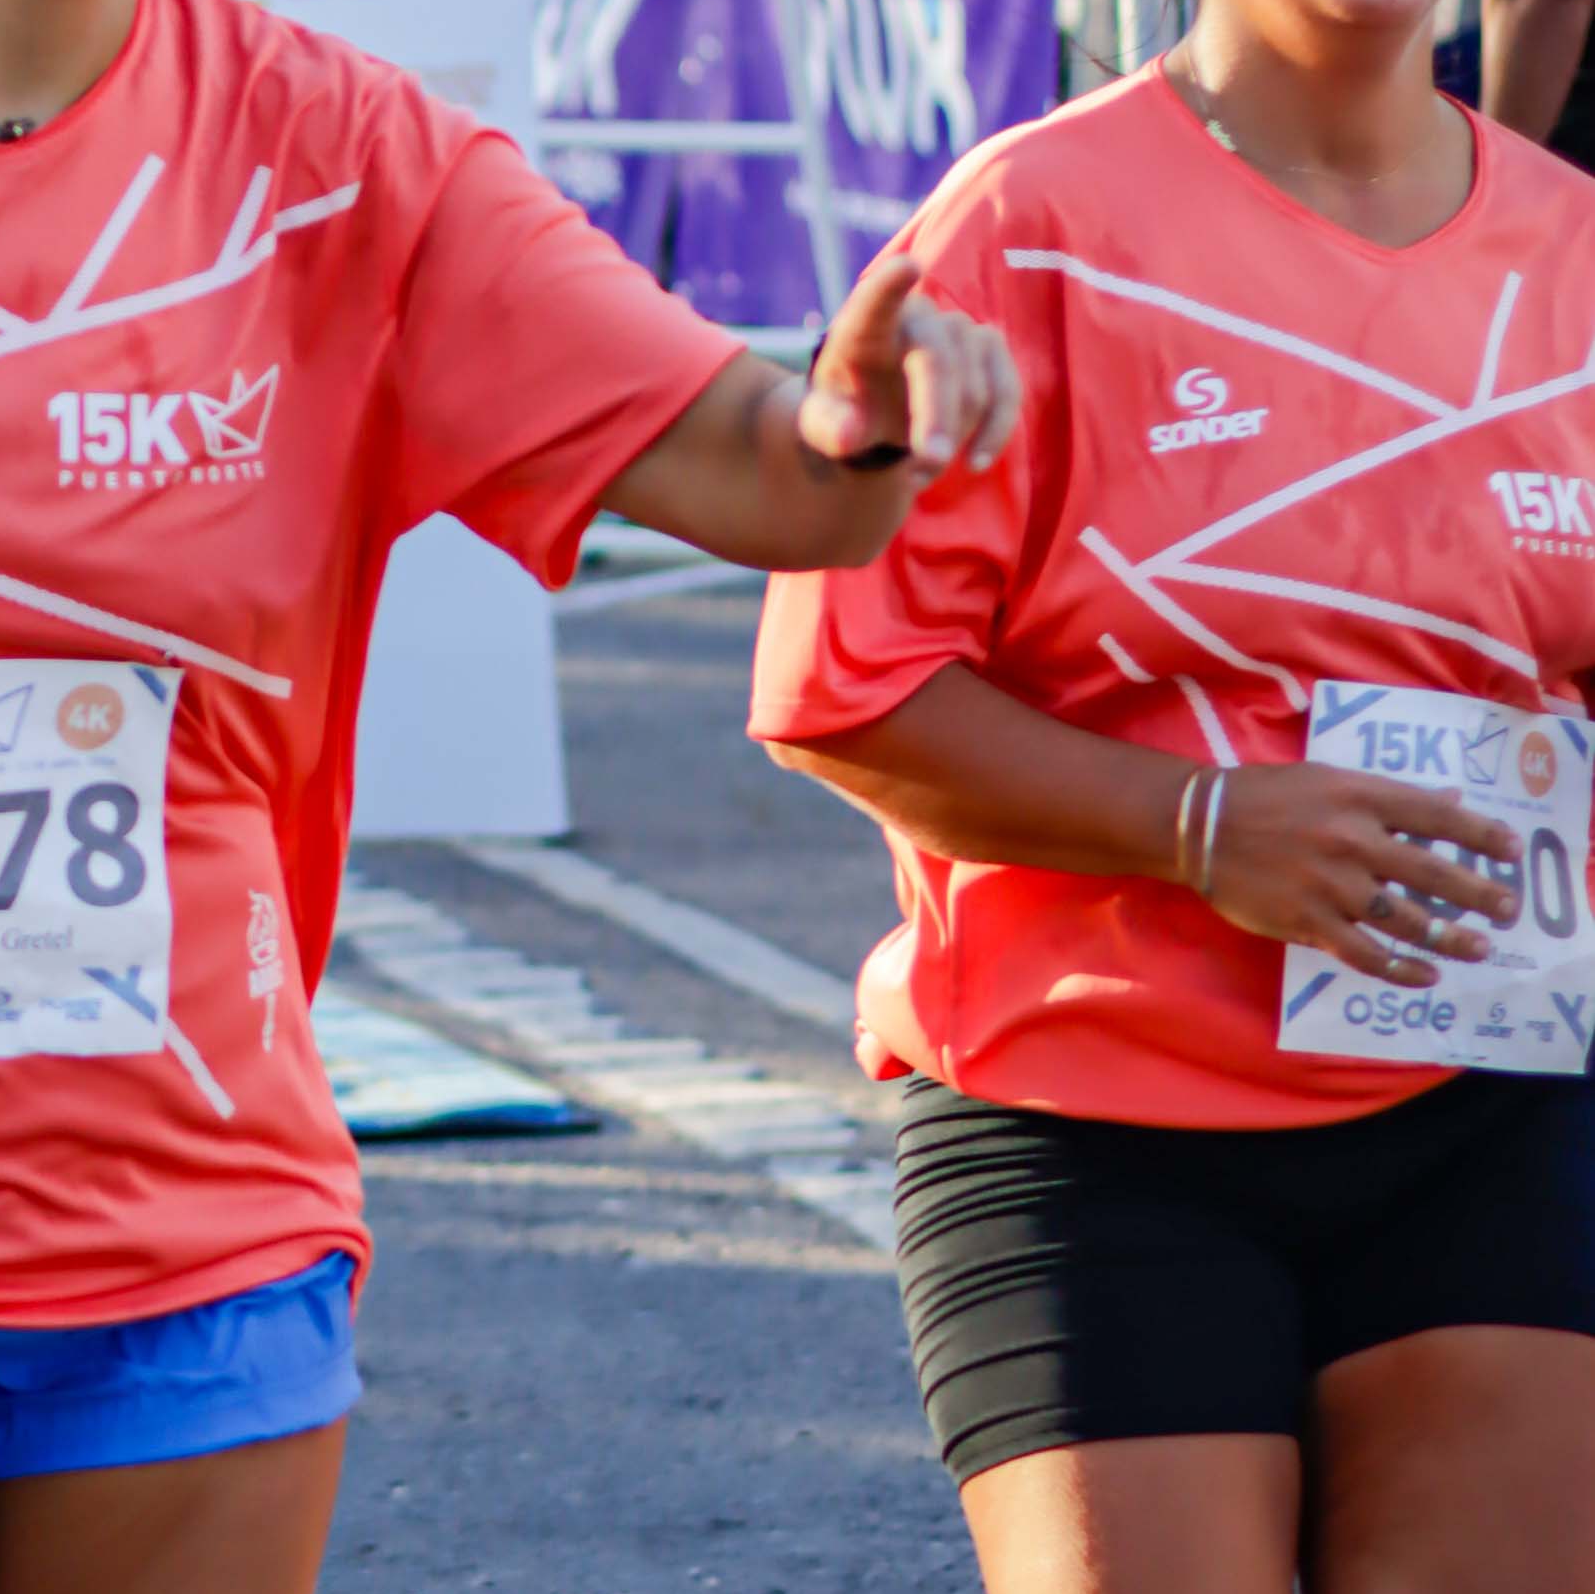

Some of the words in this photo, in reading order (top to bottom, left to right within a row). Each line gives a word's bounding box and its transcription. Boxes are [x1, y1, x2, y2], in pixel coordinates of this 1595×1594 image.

[47, 391, 189, 465] 15K
[1488, 471, 1593, 536] 15K
[66, 704, 112, 732] 4K
[1357, 720, 1449, 776] 15K
[0, 925, 75, 951] Gretel
[1343, 990, 1457, 1036] osde
